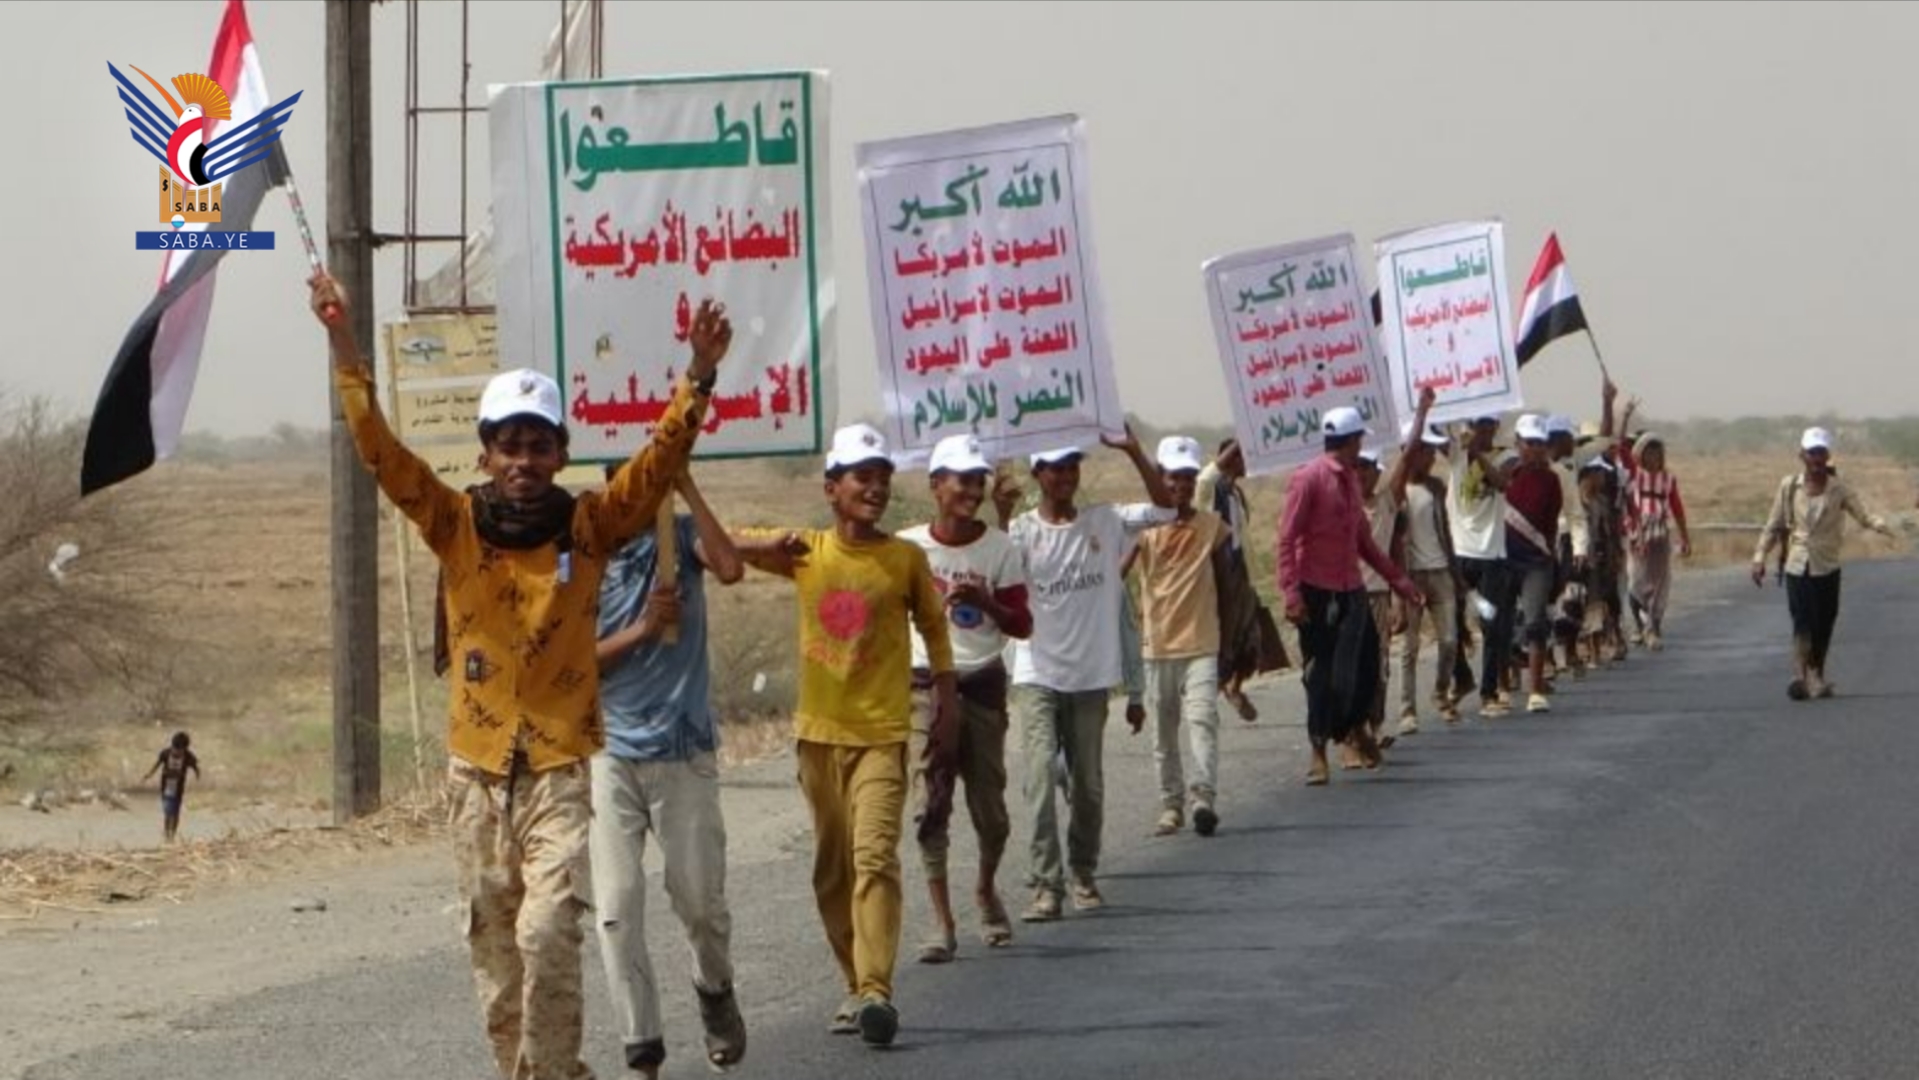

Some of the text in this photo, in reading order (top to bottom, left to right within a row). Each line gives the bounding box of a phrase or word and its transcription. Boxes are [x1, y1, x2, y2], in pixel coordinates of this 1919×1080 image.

[560, 101, 799, 191] قاطعوا
[889, 161, 1061, 236] الله أكبر
[565, 199, 799, 280] البضائع الأمريكية
[992, 226, 1066, 267] الموت
[674, 291, 691, 342] و
[999, 273, 1072, 315] الموت
[1304, 300, 1355, 331] الموت
[906, 320, 1077, 375] اللعنة على اليهود
[1312, 332, 1363, 362] الموت
[571, 362, 807, 438] الإسرئيلية
[914, 369, 1085, 438] النصر للإسلام
